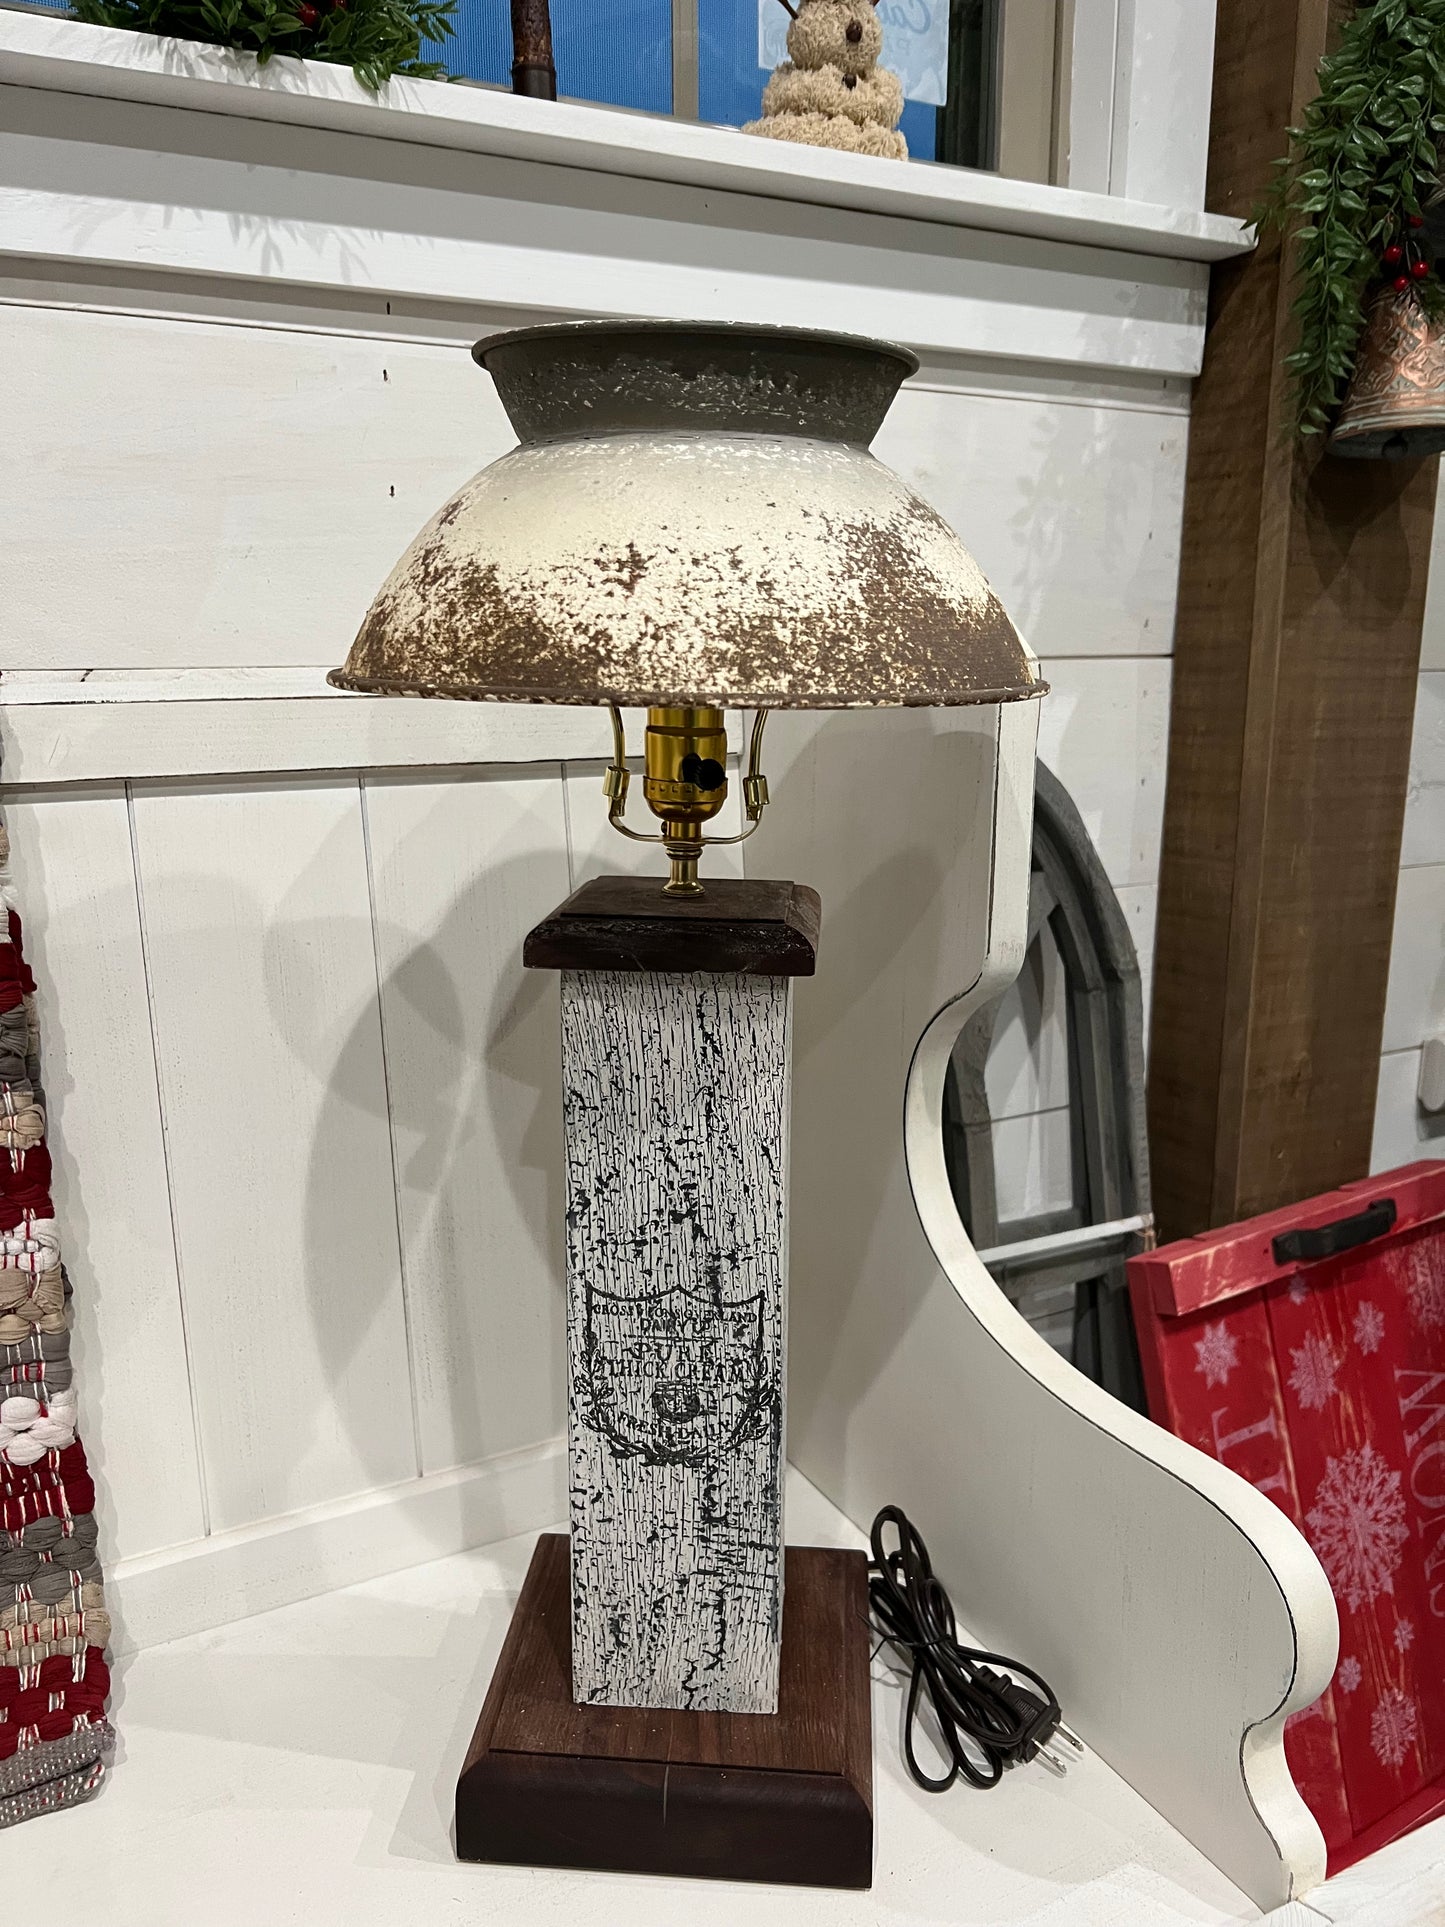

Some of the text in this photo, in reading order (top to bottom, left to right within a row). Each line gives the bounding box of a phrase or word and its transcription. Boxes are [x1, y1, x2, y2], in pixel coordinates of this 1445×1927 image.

[640, 1317, 689, 1333] DAIRY
[635, 1341, 713, 1362] PURE
[608, 1358, 743, 1382] THICK CREAM
[620, 1412, 730, 1440] FRESH DAILY
